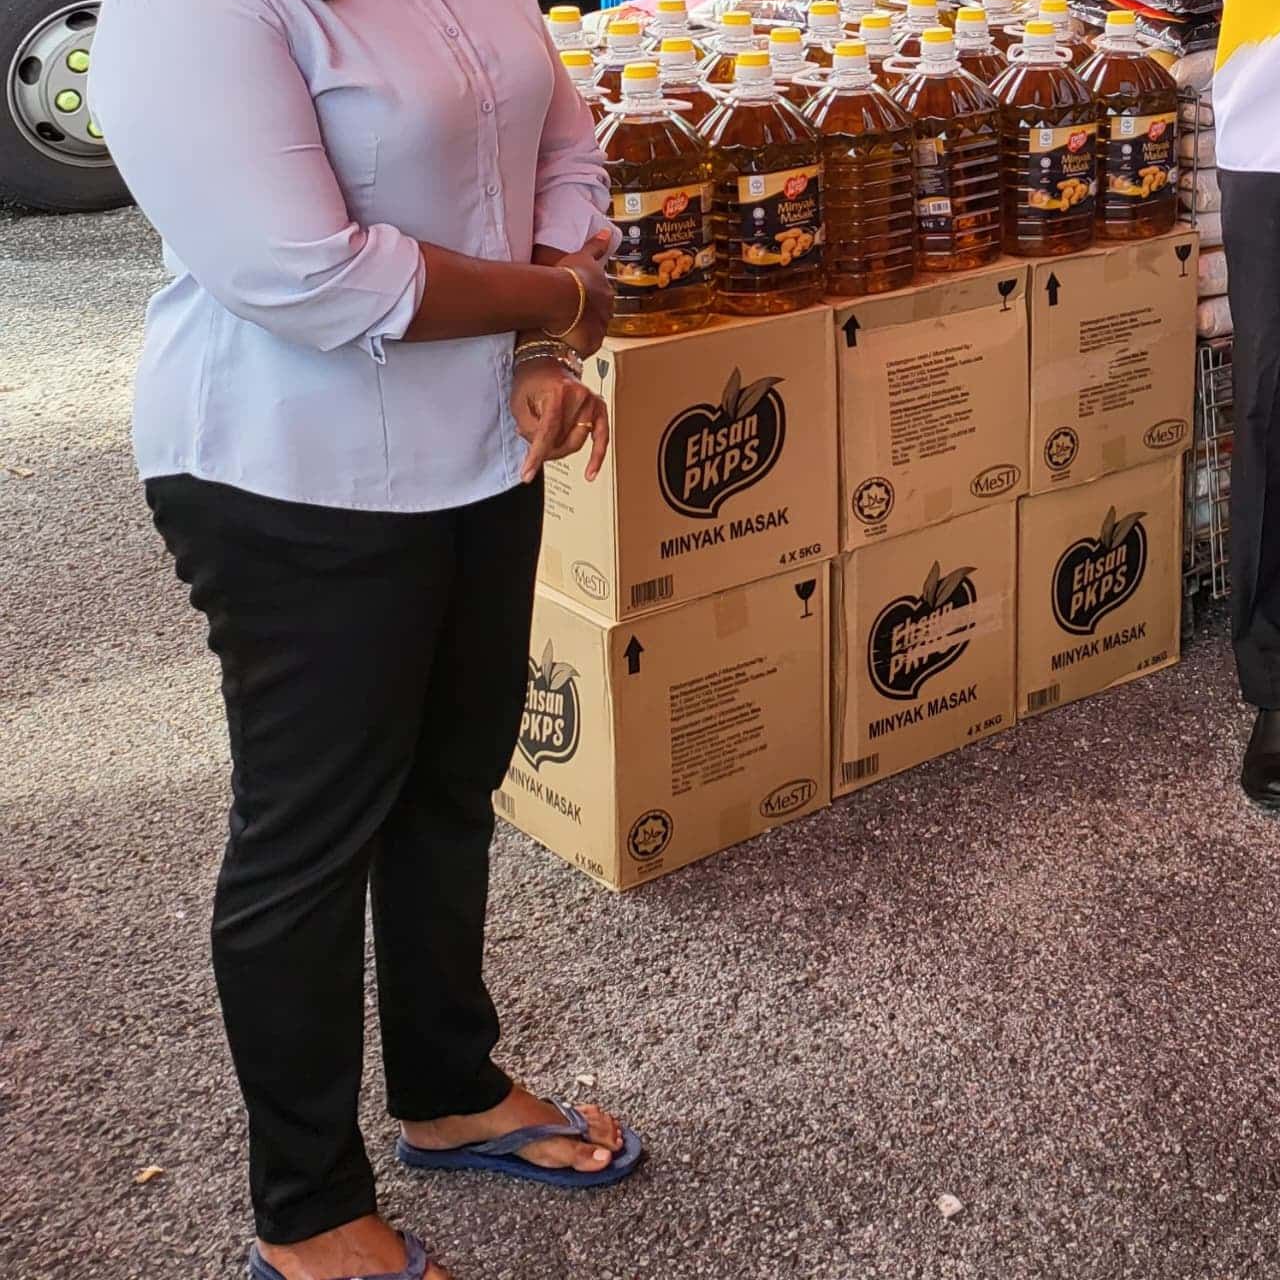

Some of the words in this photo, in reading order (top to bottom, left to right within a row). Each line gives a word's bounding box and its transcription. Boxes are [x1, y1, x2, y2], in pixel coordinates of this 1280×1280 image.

[685, 414, 759, 467] Ehsan
[1147, 424, 1184, 444] MeSTI
[682, 438, 760, 500] PKPS
[974, 469, 1016, 493] MeSTI
[660, 526, 725, 559] MINYAK
[730, 507, 789, 540] MASAK
[779, 553, 787, 565] 4
[788, 551, 797, 562] X
[799, 543, 821, 558] 5KG
[574, 565, 606, 596] MeSTI
[1072, 544, 1128, 592] Ehsan
[1070, 565, 1128, 620] PKPS
[1051, 640, 1099, 671] MINYAK
[1103, 622, 1147, 652] MASAK
[520, 710, 565, 746] PKPS
[868, 705, 924, 740] MINYAK
[928, 685, 977, 717] MASAK
[545, 787, 582, 825] MASAK
[763, 783, 812, 813] MeSTI
